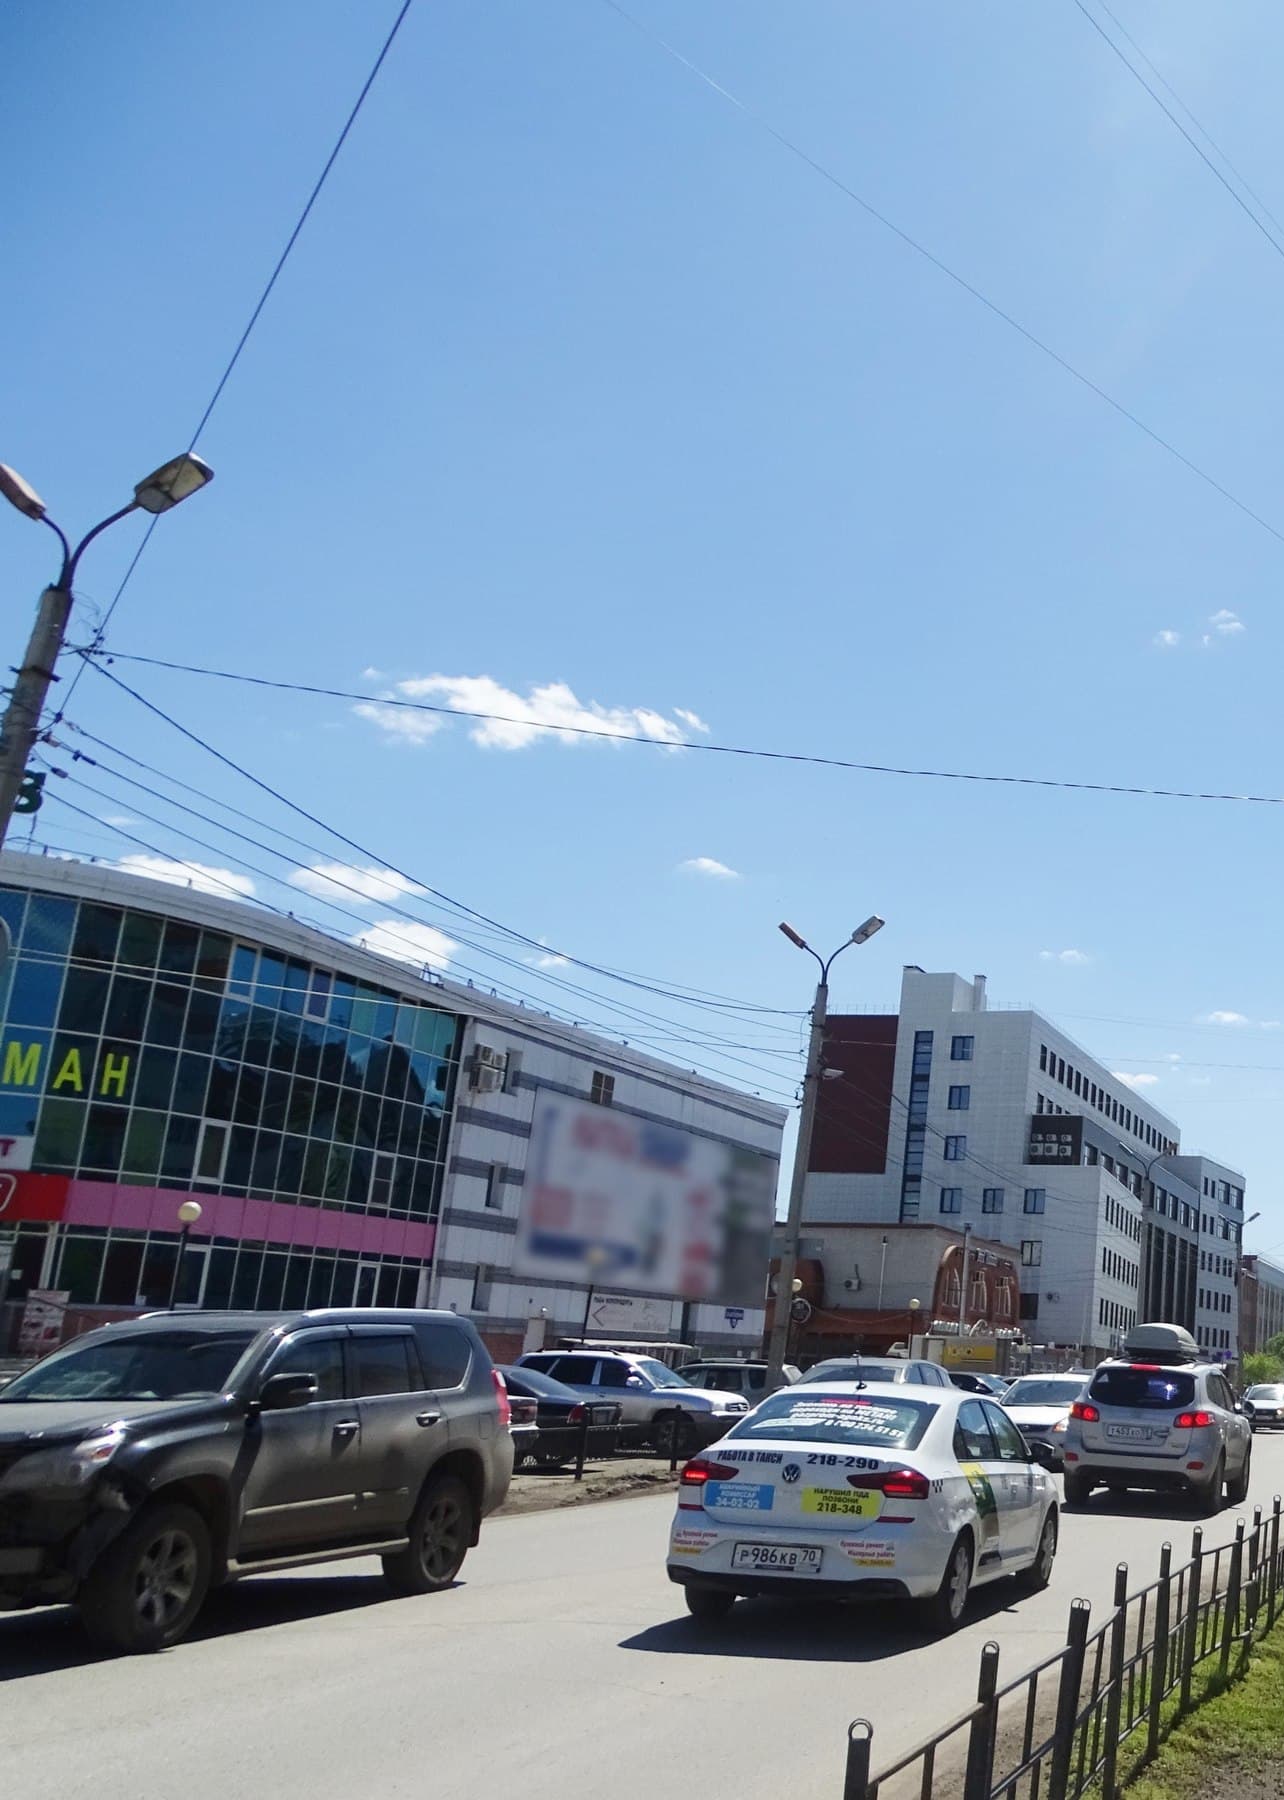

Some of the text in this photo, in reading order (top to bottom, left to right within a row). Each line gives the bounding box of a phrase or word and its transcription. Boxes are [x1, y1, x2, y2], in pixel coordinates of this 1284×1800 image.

[717, 1450, 747, 1462] РАБОТА
[747, 1452, 754, 1462] В
[807, 1453, 879, 1470] 218-290
[814, 1488, 851, 1497] НАРУШИЛ
[822, 1495, 859, 1504] ПОЗВОНИ
[817, 1502, 862, 1514] 218-348
